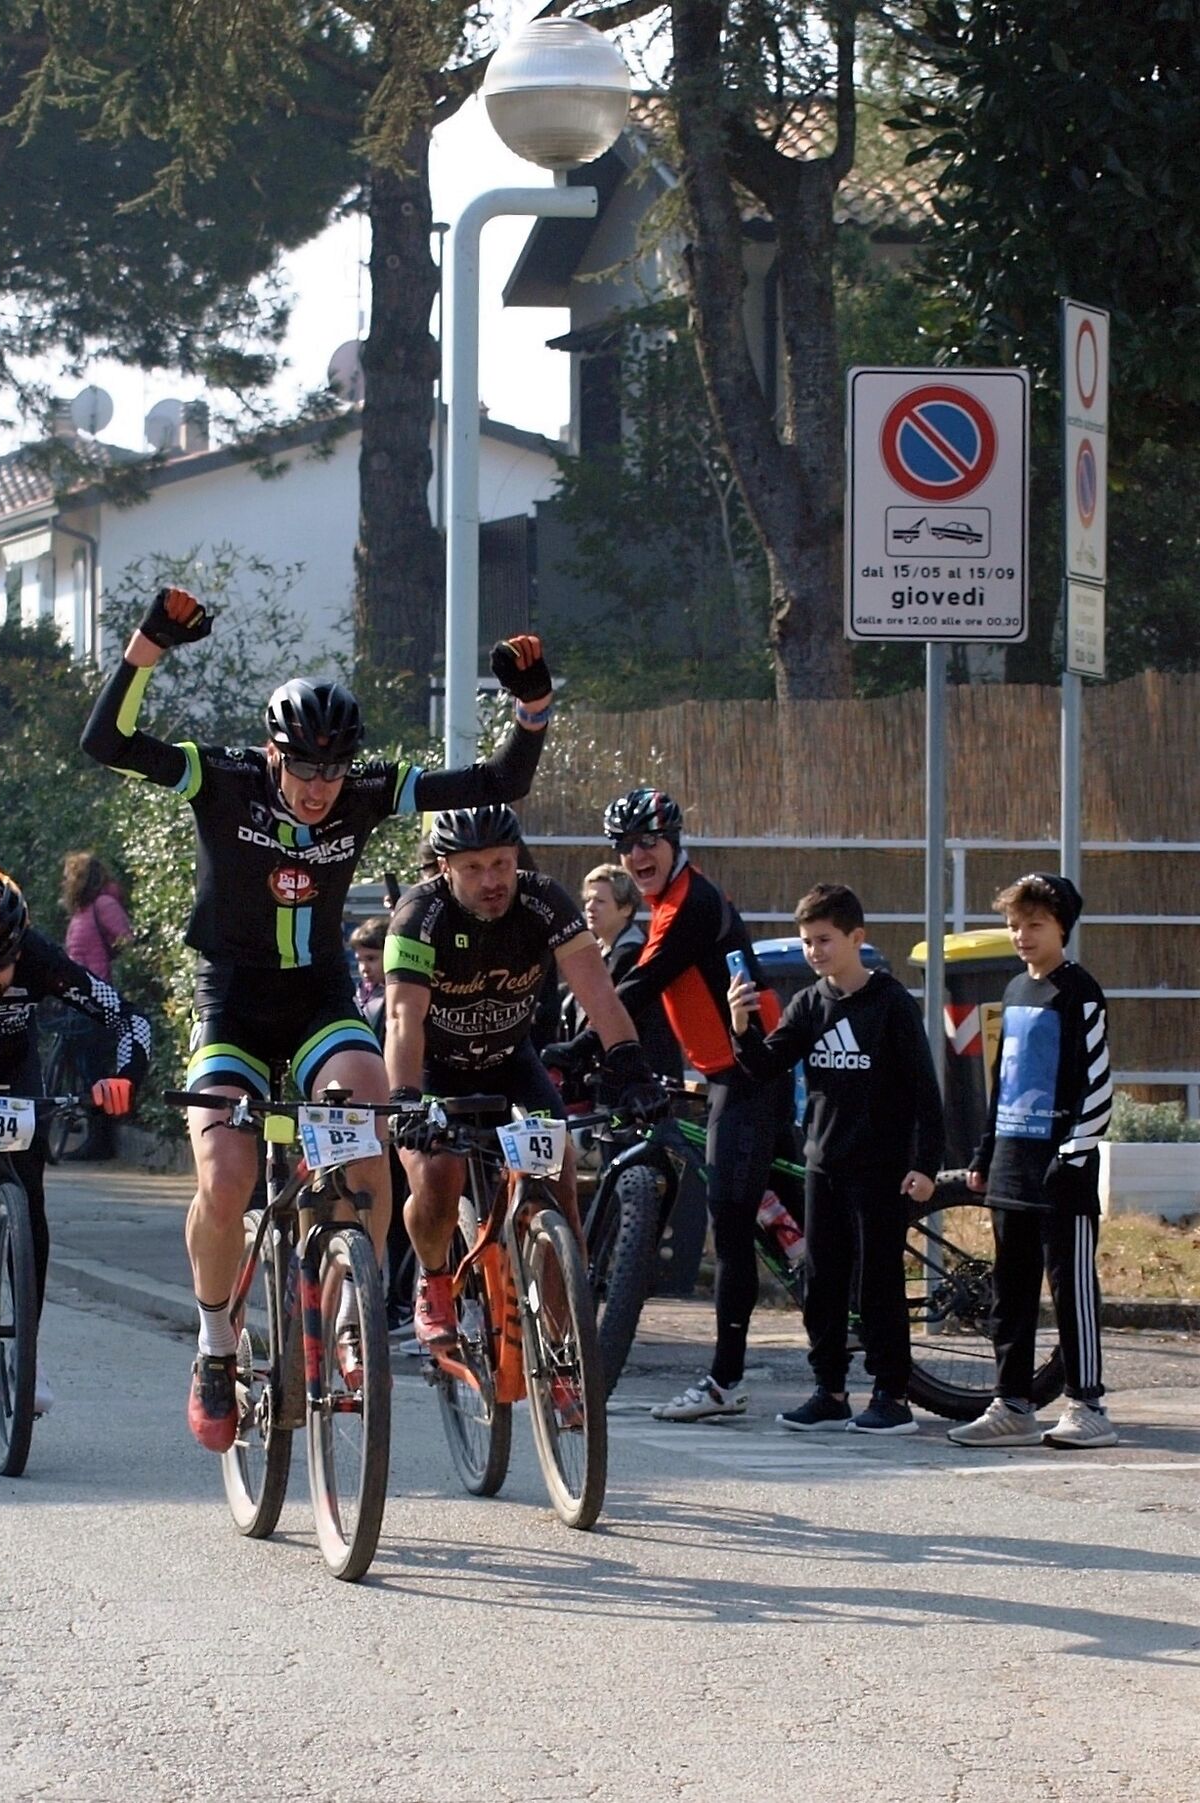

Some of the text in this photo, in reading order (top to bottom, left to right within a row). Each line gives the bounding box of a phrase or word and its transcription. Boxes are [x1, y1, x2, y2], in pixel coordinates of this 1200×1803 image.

[861, 564, 1015, 581] dal 15/05 al 15/09
[891, 586, 985, 610] giovedì
[856, 615, 883, 626] dalle
[886, 618, 904, 626] ore
[907, 616, 938, 626] 12.00
[941, 616, 962, 627] alle
[965, 618, 983, 627] ore
[808, 1050, 872, 1070] adidas
[529, 1136, 554, 1160] 43
